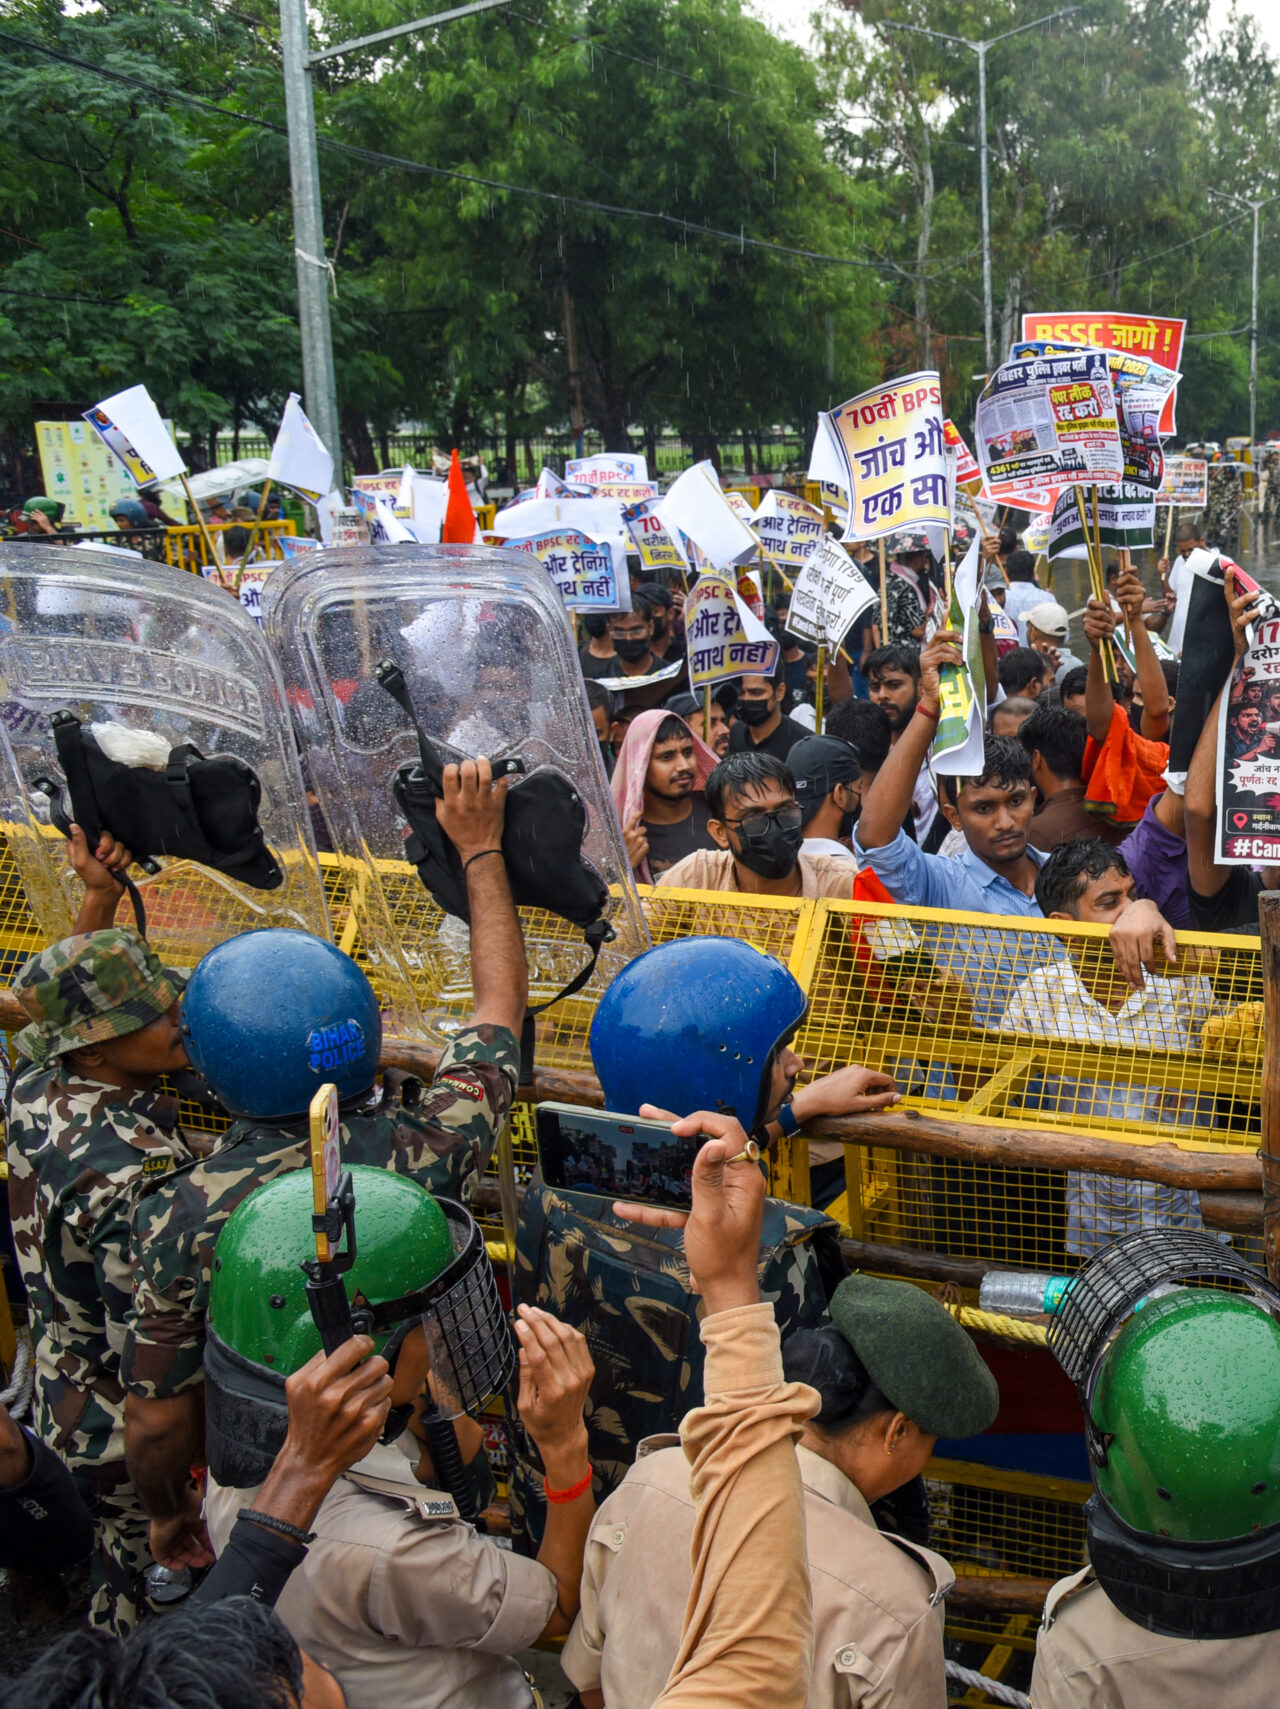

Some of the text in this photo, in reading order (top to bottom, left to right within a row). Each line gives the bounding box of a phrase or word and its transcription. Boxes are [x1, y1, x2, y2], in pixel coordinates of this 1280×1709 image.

[1035, 320, 1173, 352] BSSC जागो !
[1124, 359, 1149, 376] 2025
[846, 387, 941, 429] 70वीं BPS
[1056, 398, 1099, 420] रद्द करो
[854, 436, 907, 480] जांच
[990, 463, 1010, 474] 4361
[634, 486, 651, 497] करो
[862, 483, 904, 524] एक
[786, 515, 821, 537] ट्रेनिंग
[1099, 510, 1118, 523] साथ
[572, 551, 608, 574] ट्रेनिंग
[583, 577, 612, 597] नहीं
[695, 608, 720, 637] और
[693, 647, 725, 672] साथ
[1253, 764, 1271, 773] जांच
[1239, 775, 1264, 787] पूर्णतः
[1267, 777, 1277, 785] रद्द
[312, 1022, 359, 1052] BIHAR
[310, 1039, 364, 1068] POLICE
